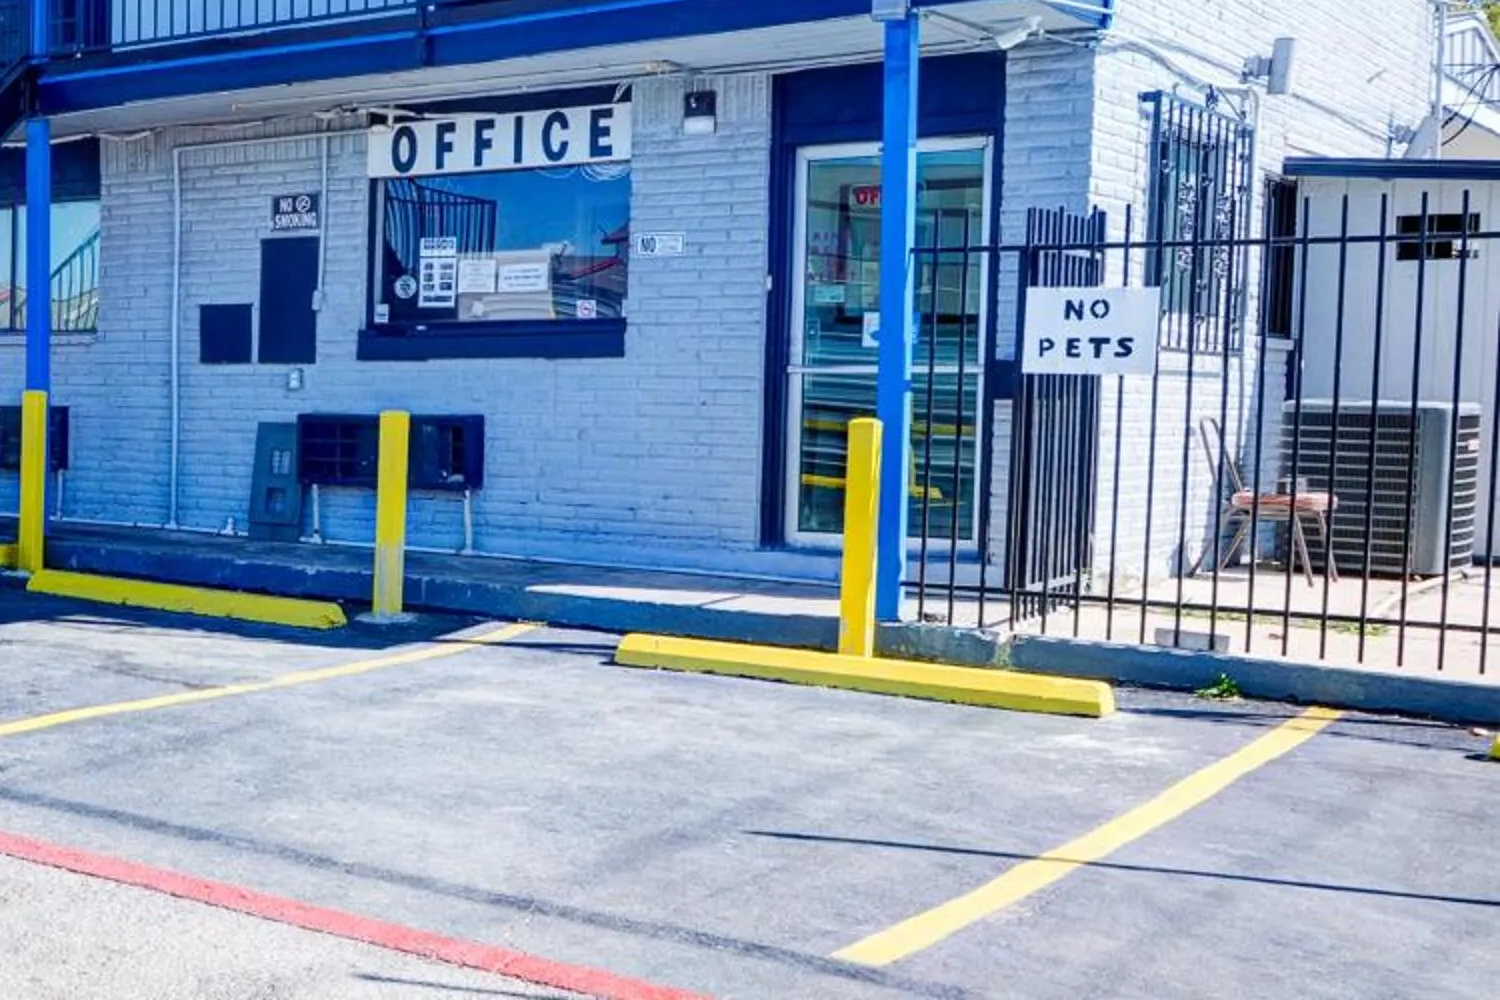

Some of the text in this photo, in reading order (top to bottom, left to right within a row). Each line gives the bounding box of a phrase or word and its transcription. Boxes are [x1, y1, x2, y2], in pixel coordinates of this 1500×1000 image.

[391, 108, 614, 173] OFFICE
[279, 197, 293, 213] NO
[275, 212, 317, 229] SMOKING
[1064, 299, 1110, 321] NO
[1039, 337, 1134, 358] PETS
